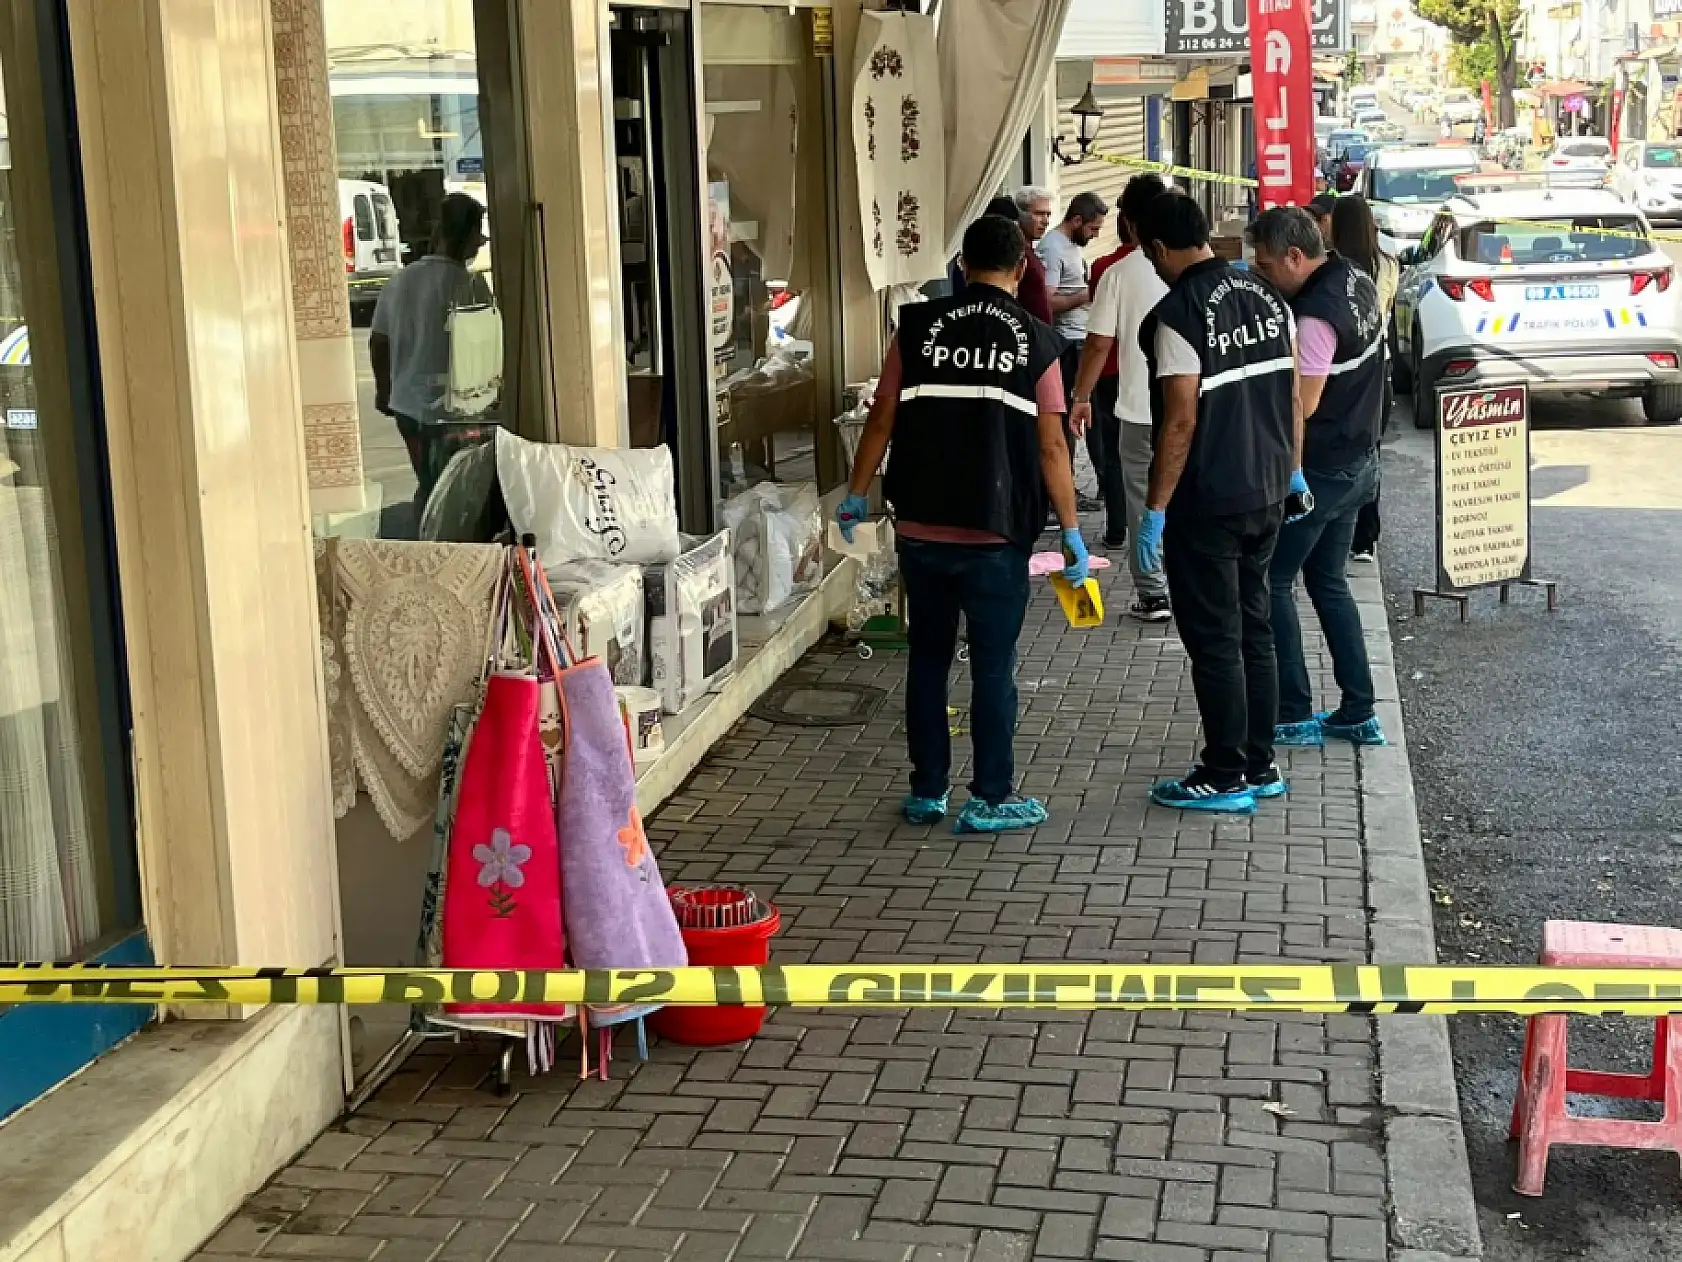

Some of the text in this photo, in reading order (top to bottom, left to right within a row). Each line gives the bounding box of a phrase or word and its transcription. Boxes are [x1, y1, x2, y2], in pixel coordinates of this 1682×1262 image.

[922, 318, 945, 357] OLAY
[946, 302, 984, 321] YERİ
[1218, 313, 1280, 355] POLİS
[933, 342, 1015, 373] POLİS
